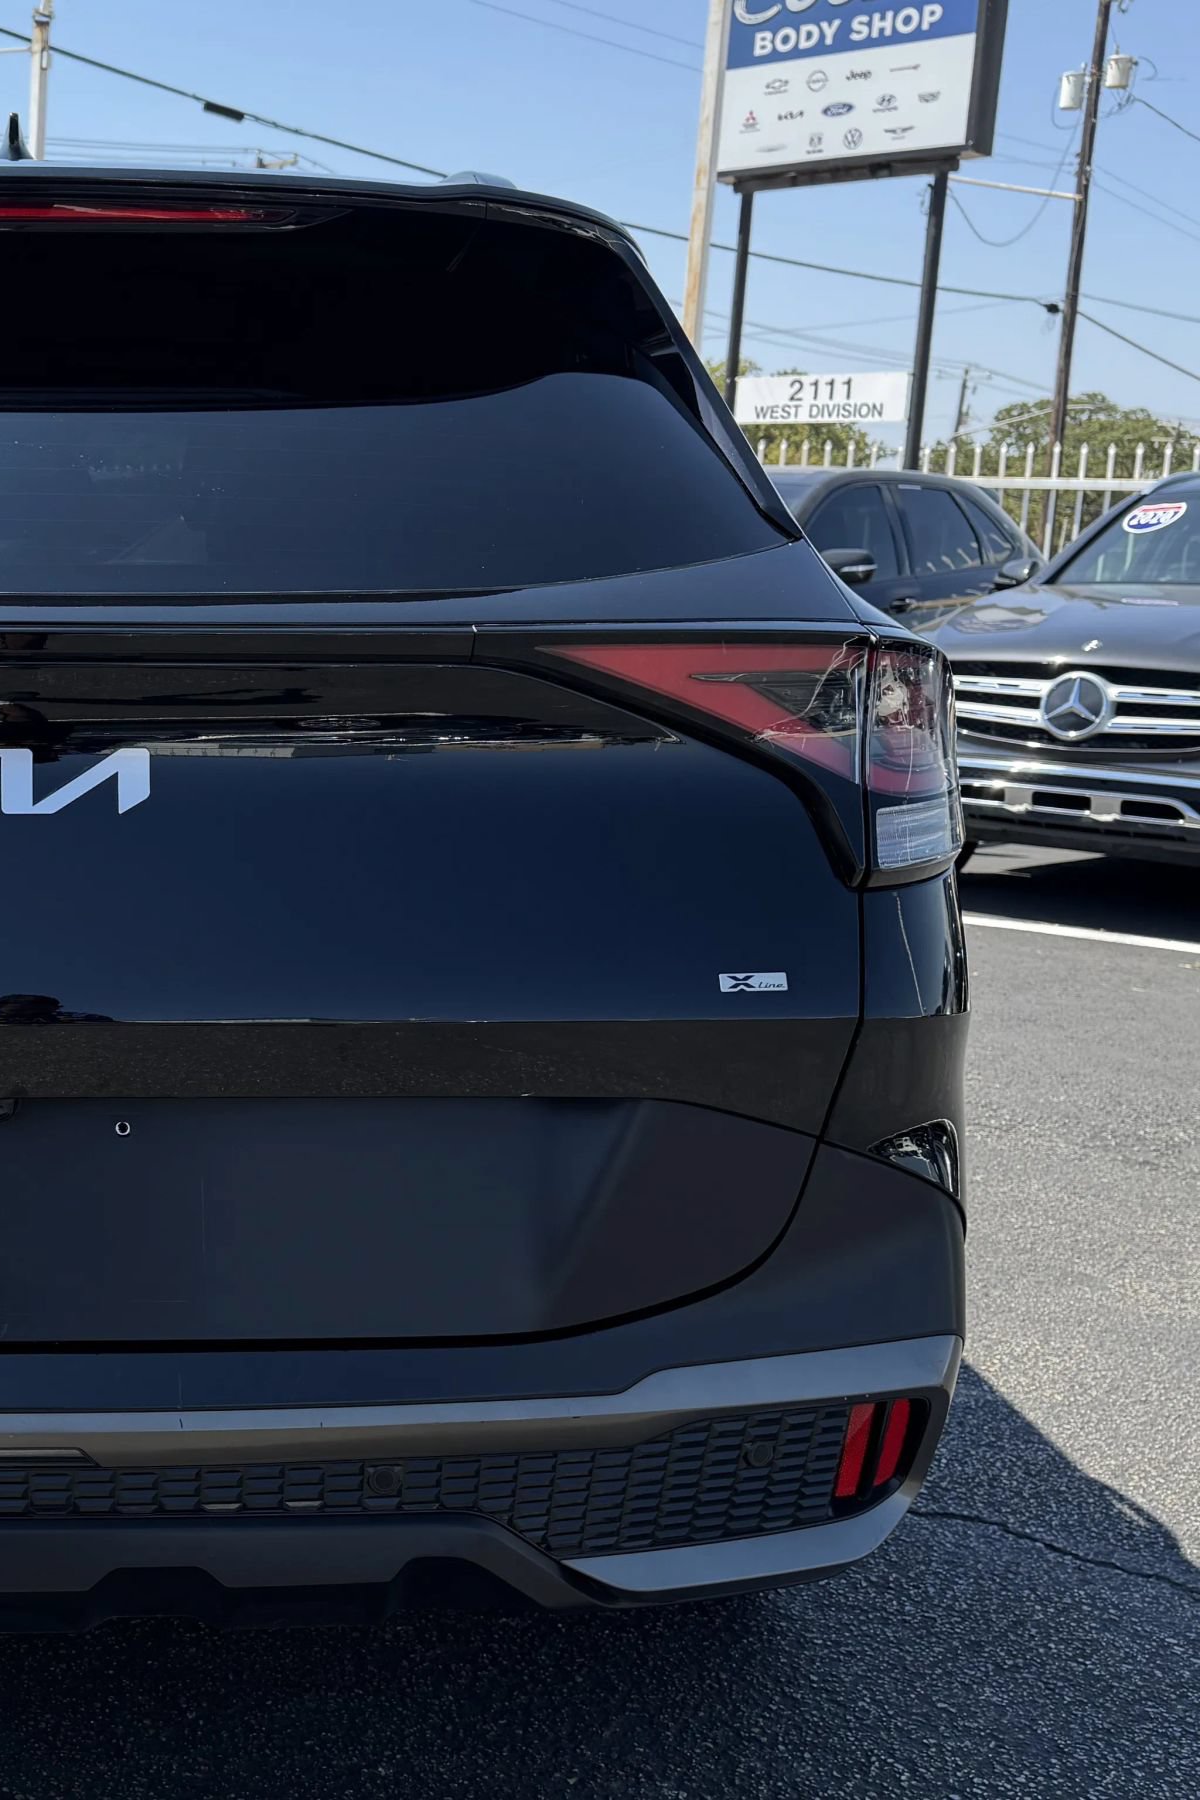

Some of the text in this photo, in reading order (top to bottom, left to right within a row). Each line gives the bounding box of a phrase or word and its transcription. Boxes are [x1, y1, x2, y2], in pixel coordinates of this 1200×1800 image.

[753, 18, 842, 57] BODY
[849, 3, 944, 42] SHOP
[845, 69, 872, 81] Jeep
[789, 377, 853, 401] 2111
[754, 403, 884, 420] WEST DIVISION
